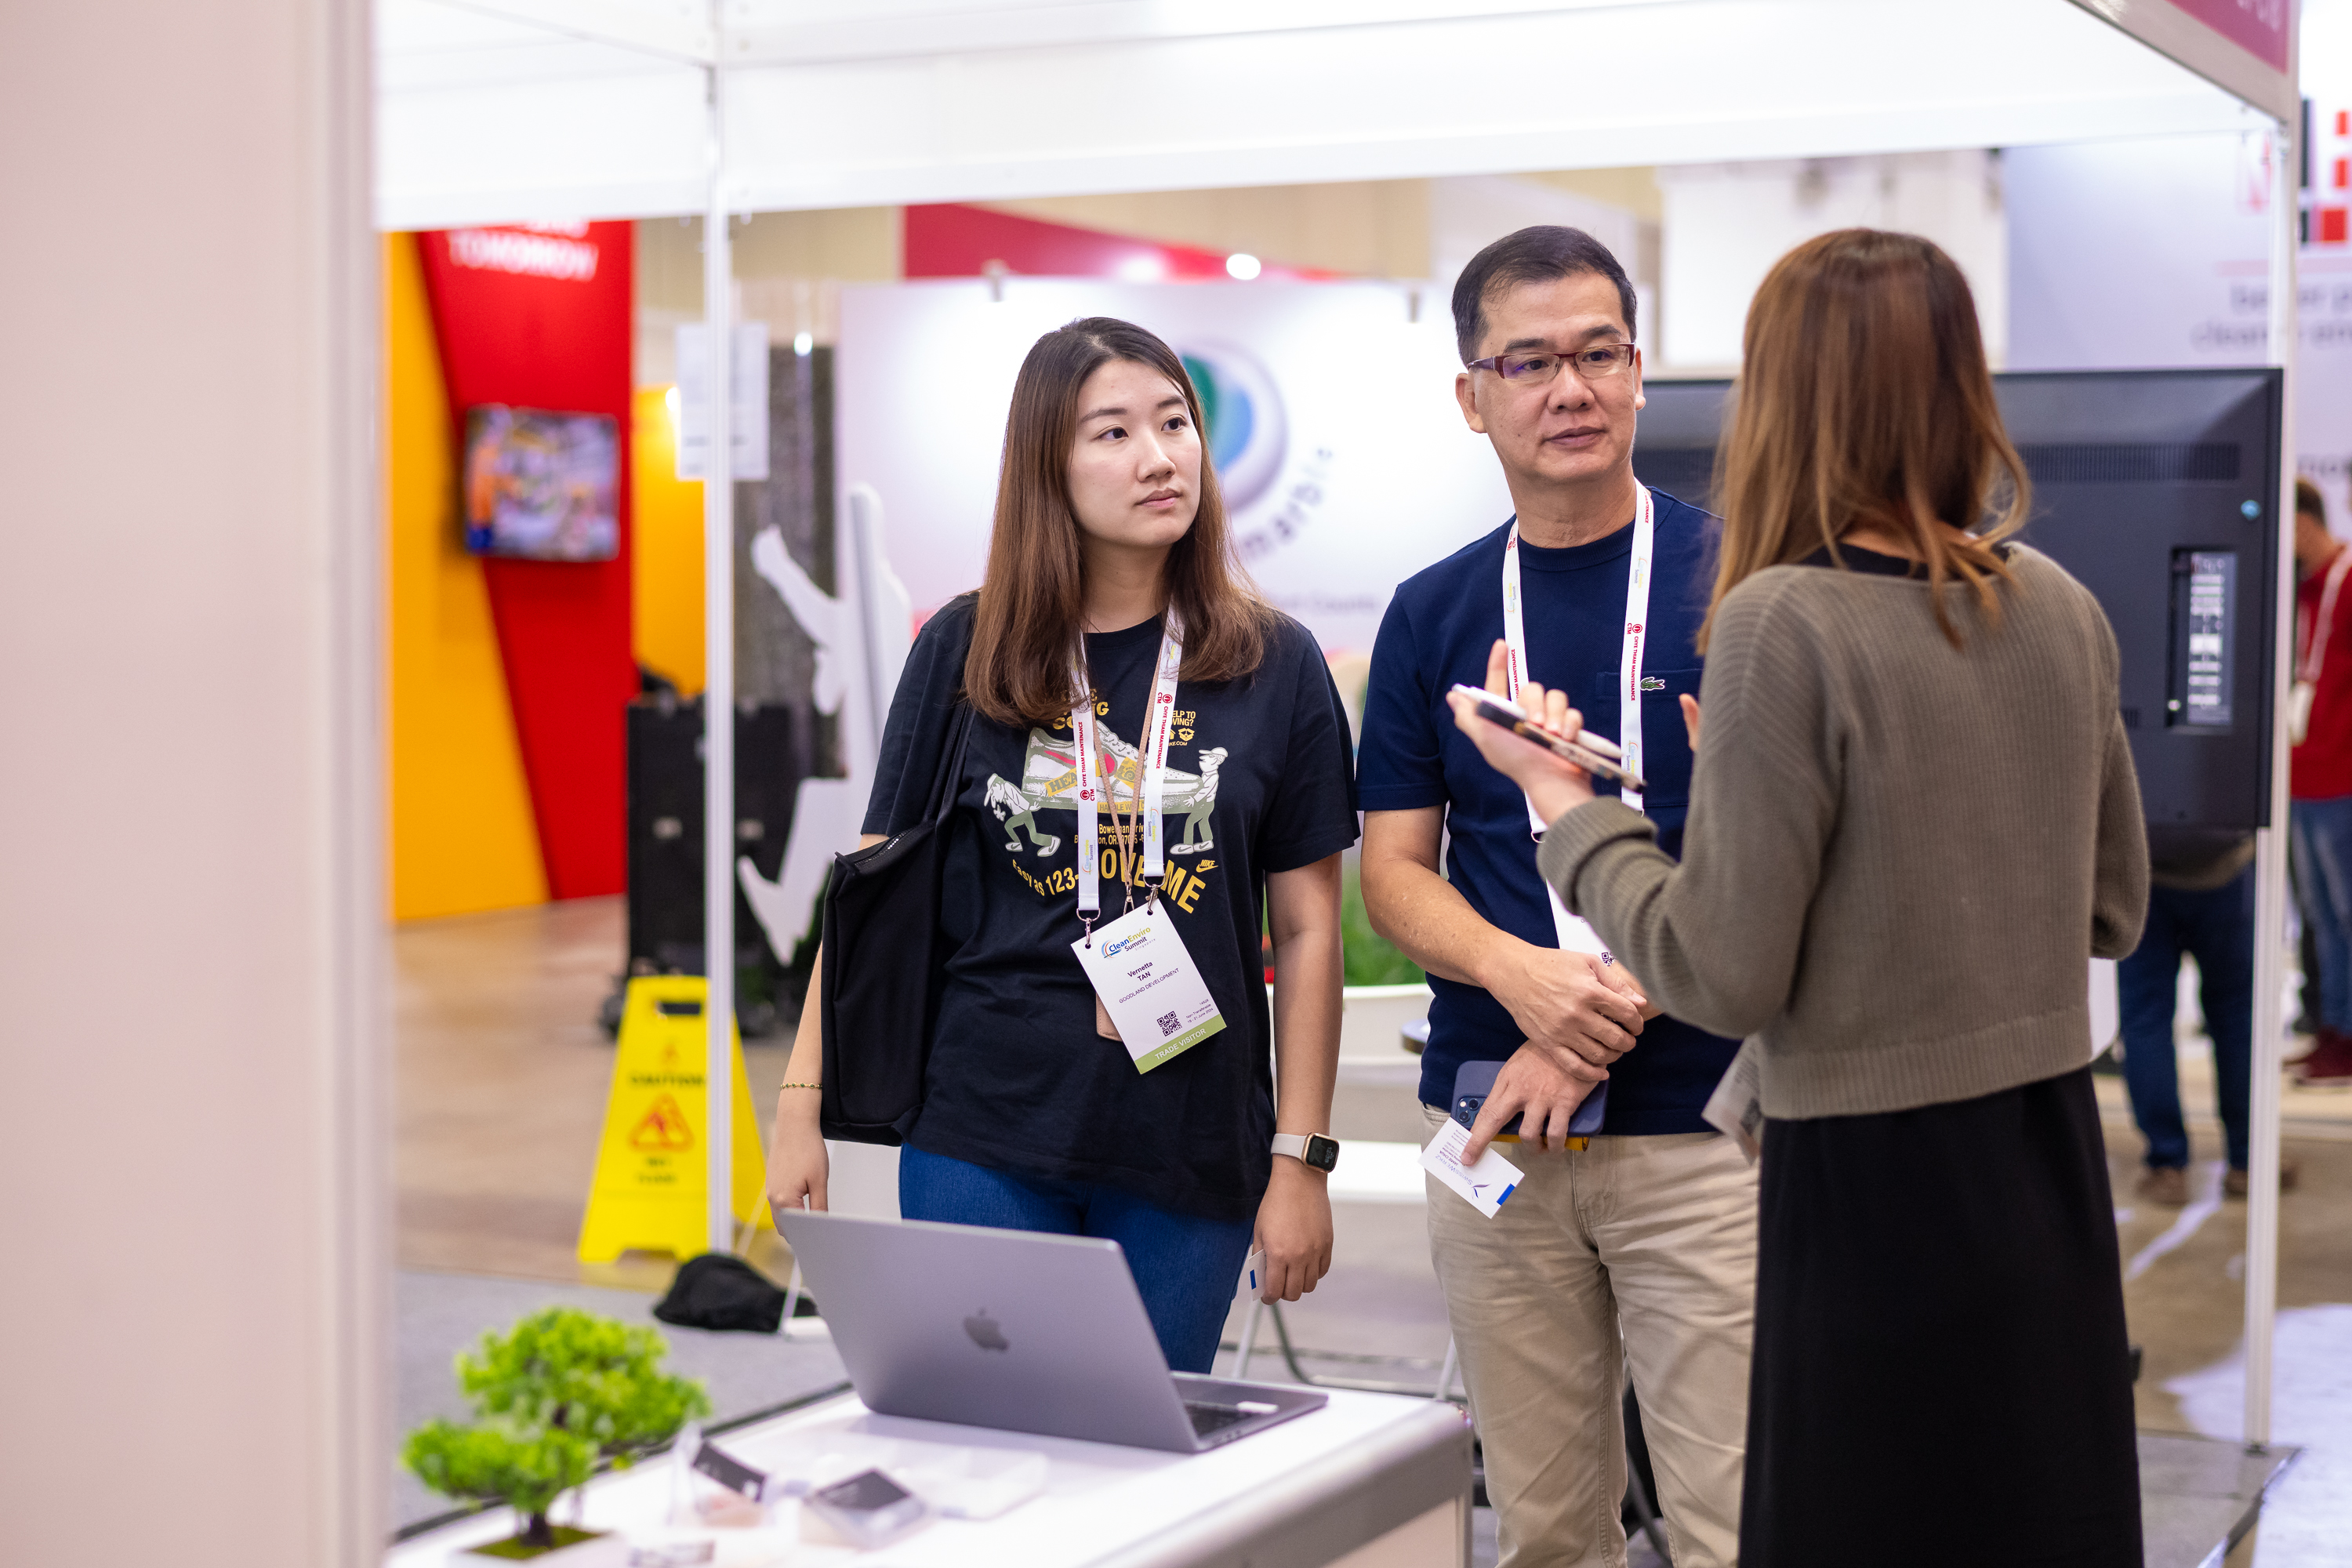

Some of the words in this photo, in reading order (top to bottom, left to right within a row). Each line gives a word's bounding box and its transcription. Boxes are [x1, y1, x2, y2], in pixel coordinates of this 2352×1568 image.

[1172, 717, 1194, 727] VING?
[1173, 710, 1185, 718] ELP
[1185, 710, 1196, 720] TO
[1155, 734, 1166, 770] MAINTENANCE
[1200, 858, 1216, 868] NIKE
[1033, 879, 1045, 896] as
[1160, 859, 1207, 914] ME
[1109, 927, 1150, 952] CleanEnviro
[1124, 936, 1148, 952] Summit
[1127, 961, 1153, 978] Vernetta
[1137, 971, 1152, 982] TAN
[1119, 986, 1145, 1004] GOODLAND
[1145, 967, 1179, 989] DEVELOPMENT
[1155, 1043, 1179, 1060] TRADE
[1178, 1028, 1207, 1047] VISITOR
